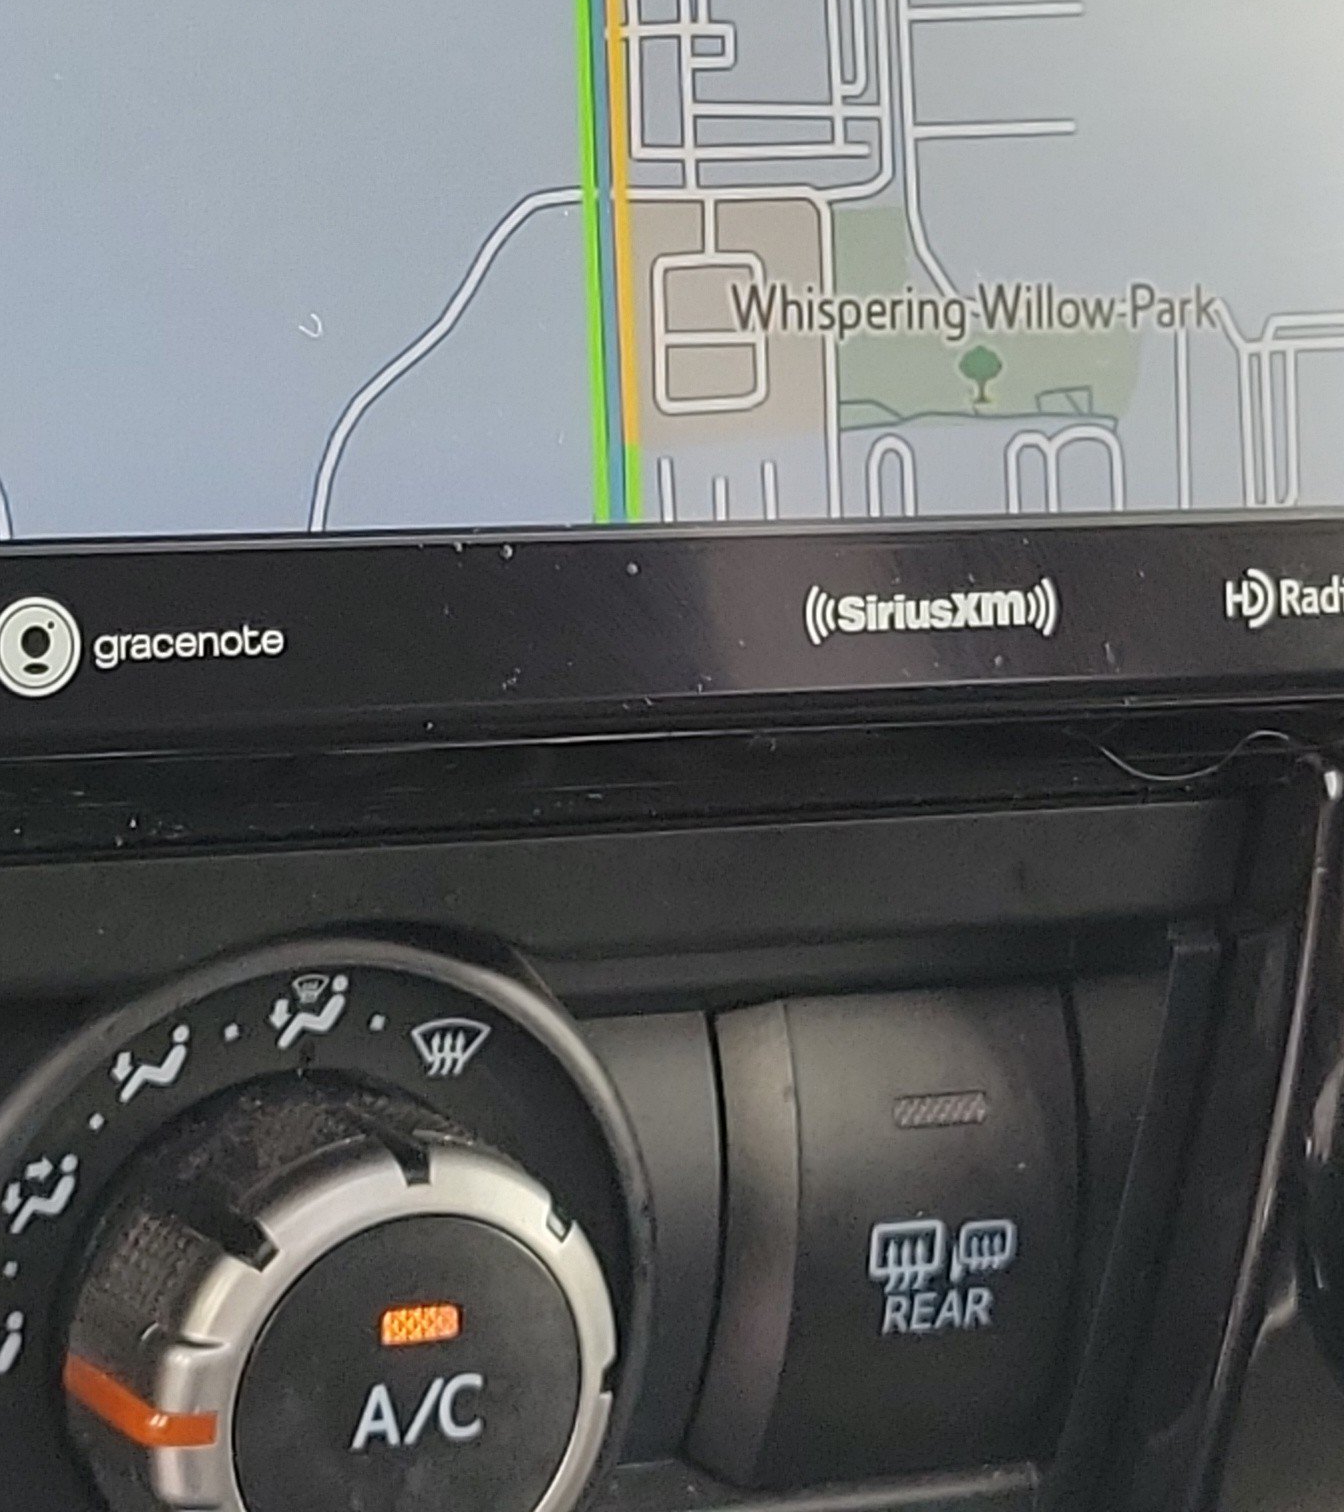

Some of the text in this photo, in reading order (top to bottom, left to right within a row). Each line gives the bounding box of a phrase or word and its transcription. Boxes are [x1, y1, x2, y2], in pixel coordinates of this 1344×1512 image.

[730, 283, 1219, 341] Whispering Willow Park
[93, 624, 286, 671] gracenote
[882, 1287, 993, 1334] REAR
[352, 1372, 484, 1450] A/C
